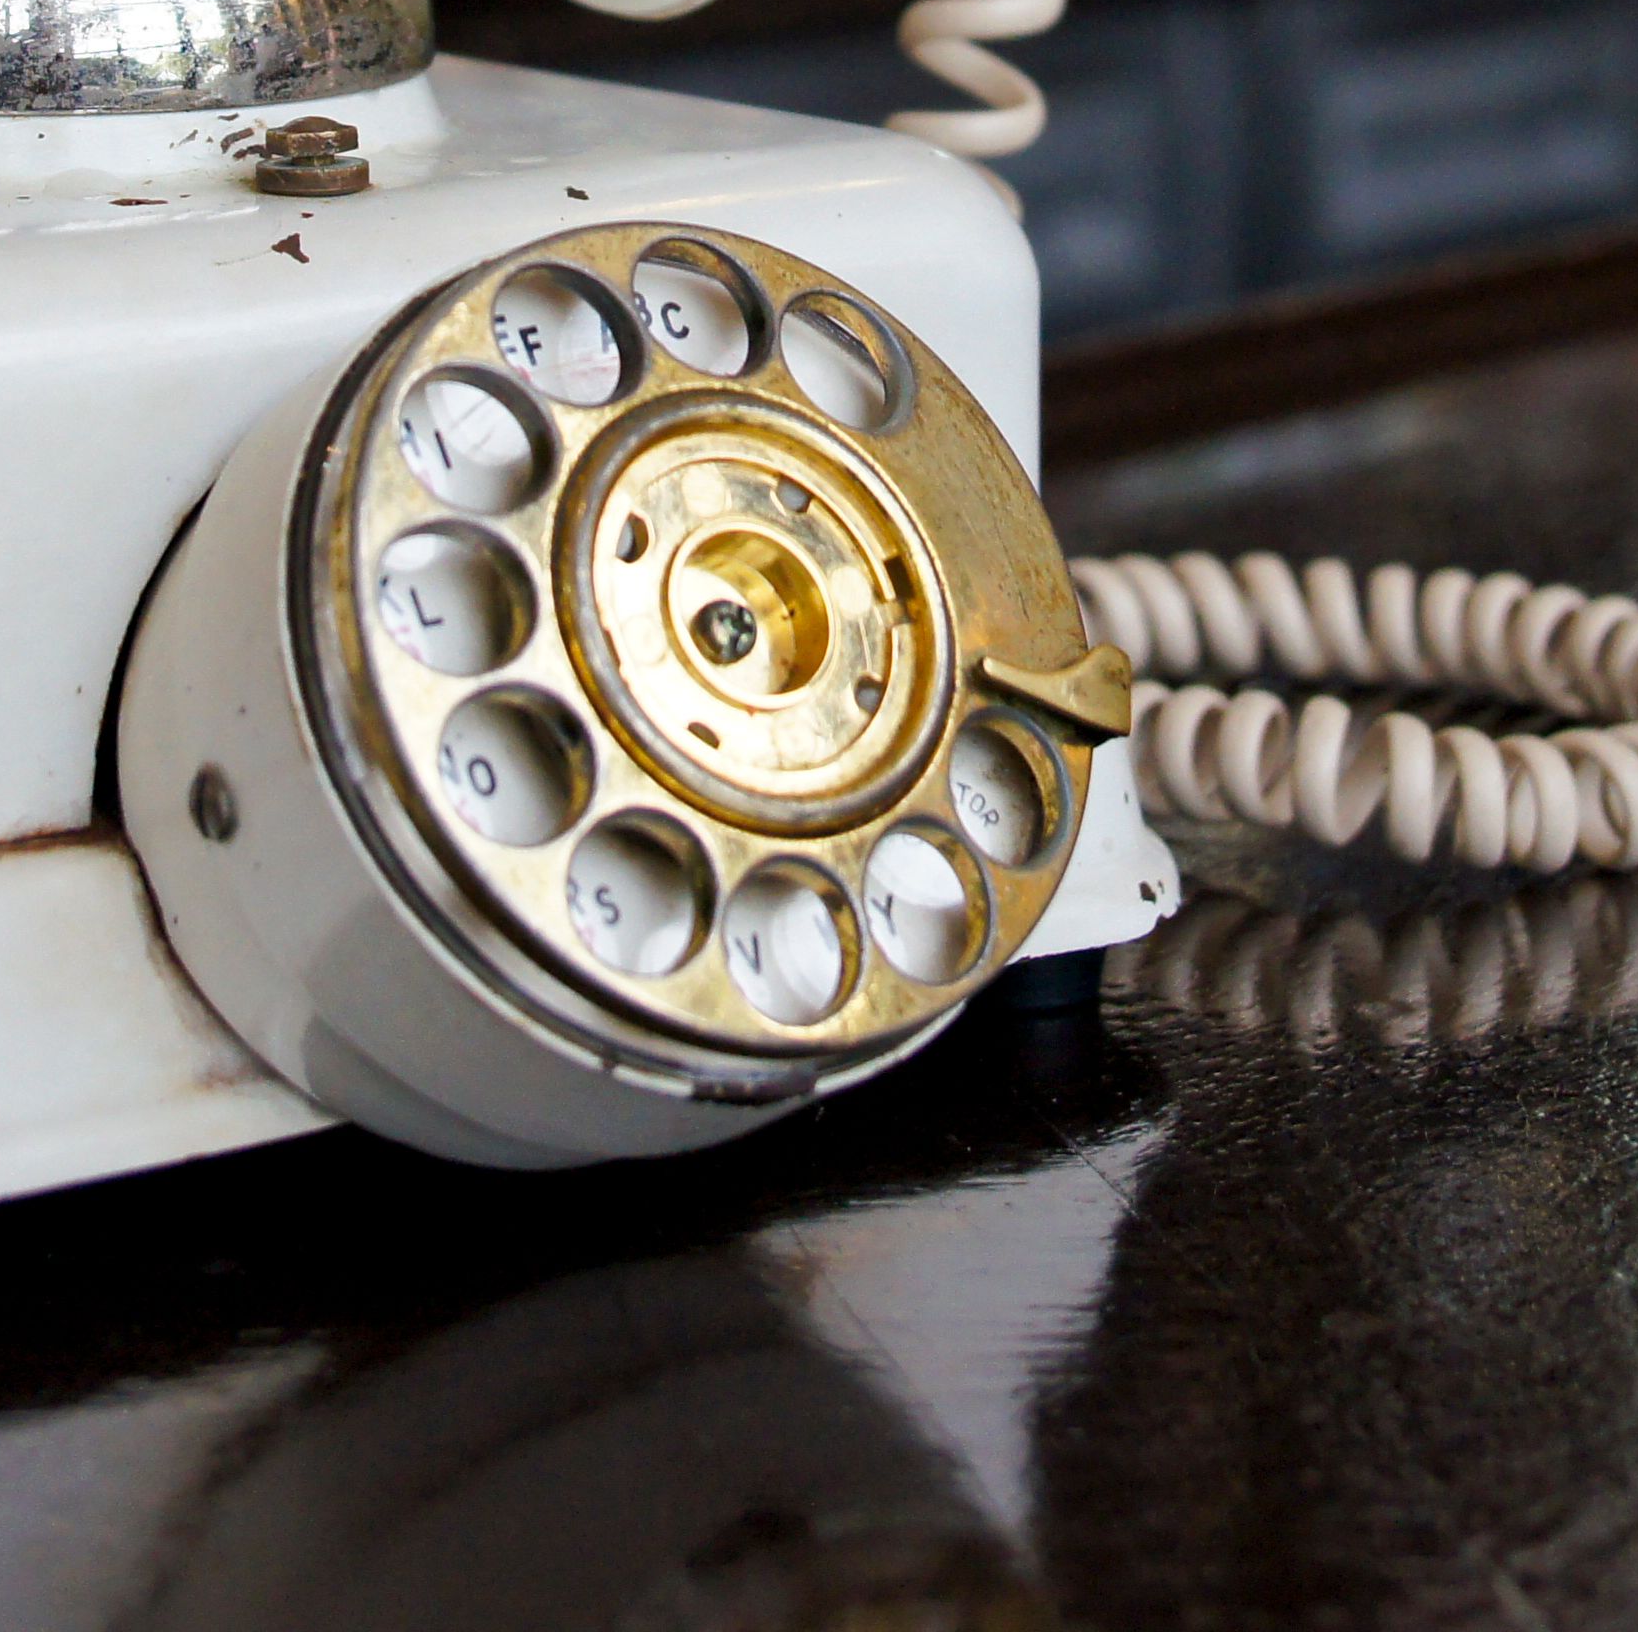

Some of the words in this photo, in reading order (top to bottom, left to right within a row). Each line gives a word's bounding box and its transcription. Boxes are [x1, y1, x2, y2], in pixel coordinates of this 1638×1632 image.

[955, 781, 1001, 828] TOR
[870, 894, 898, 937] Y
[734, 930, 762, 975] V
